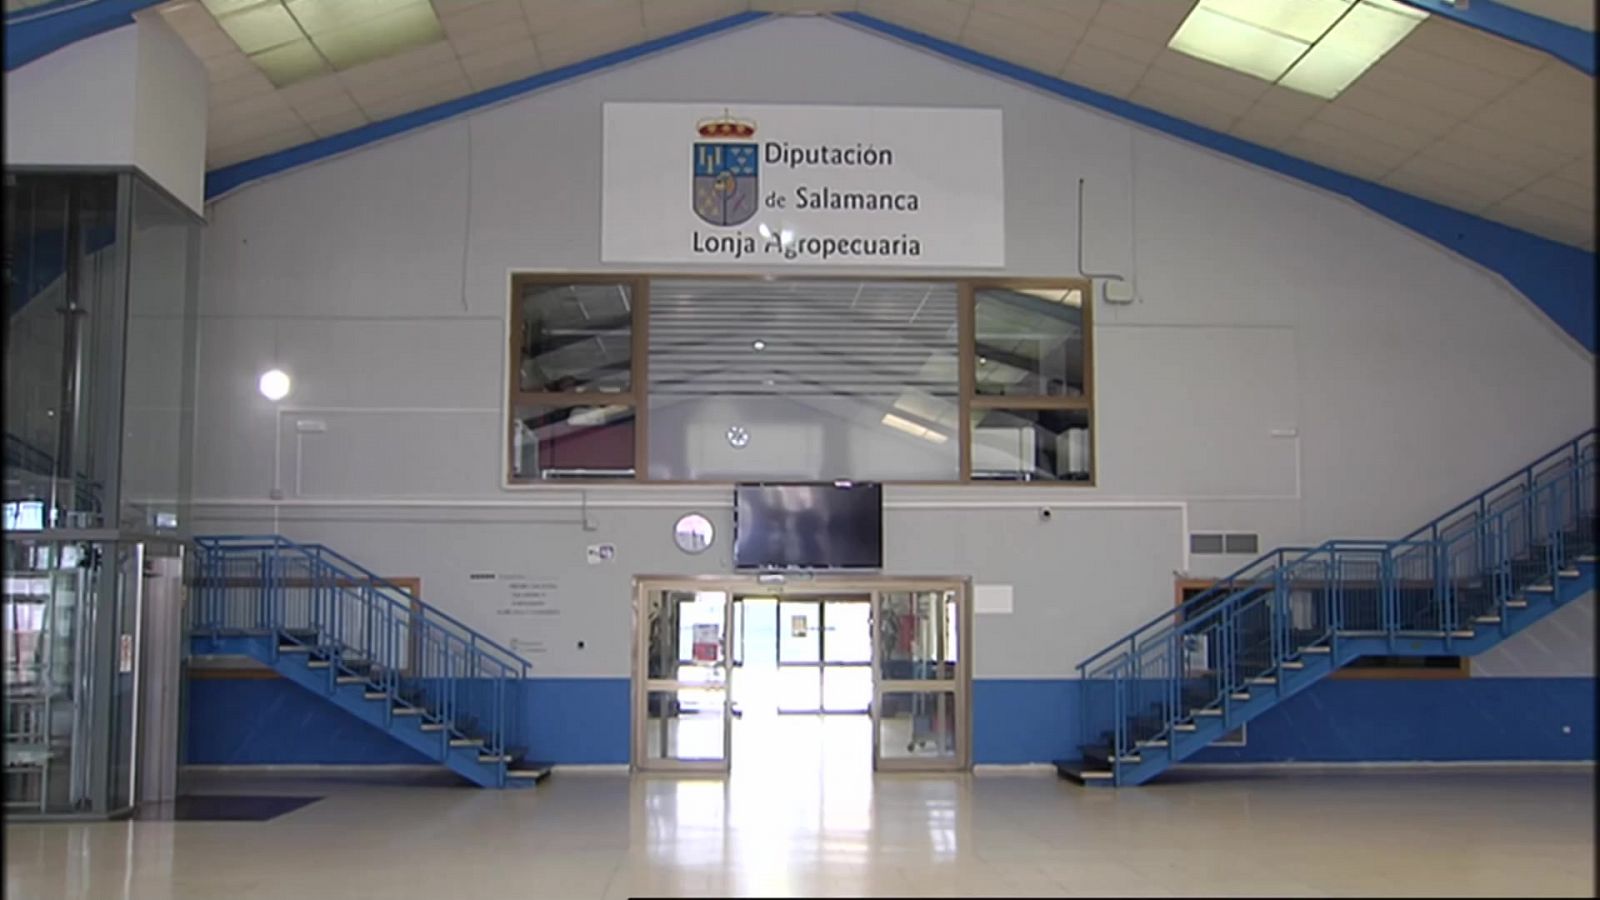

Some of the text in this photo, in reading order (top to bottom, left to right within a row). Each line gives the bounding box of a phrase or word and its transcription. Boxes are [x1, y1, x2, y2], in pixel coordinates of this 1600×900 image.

[764, 141, 893, 169] Diputación
[765, 186, 919, 211] de Salamanca
[693, 231, 755, 258] Lonja
